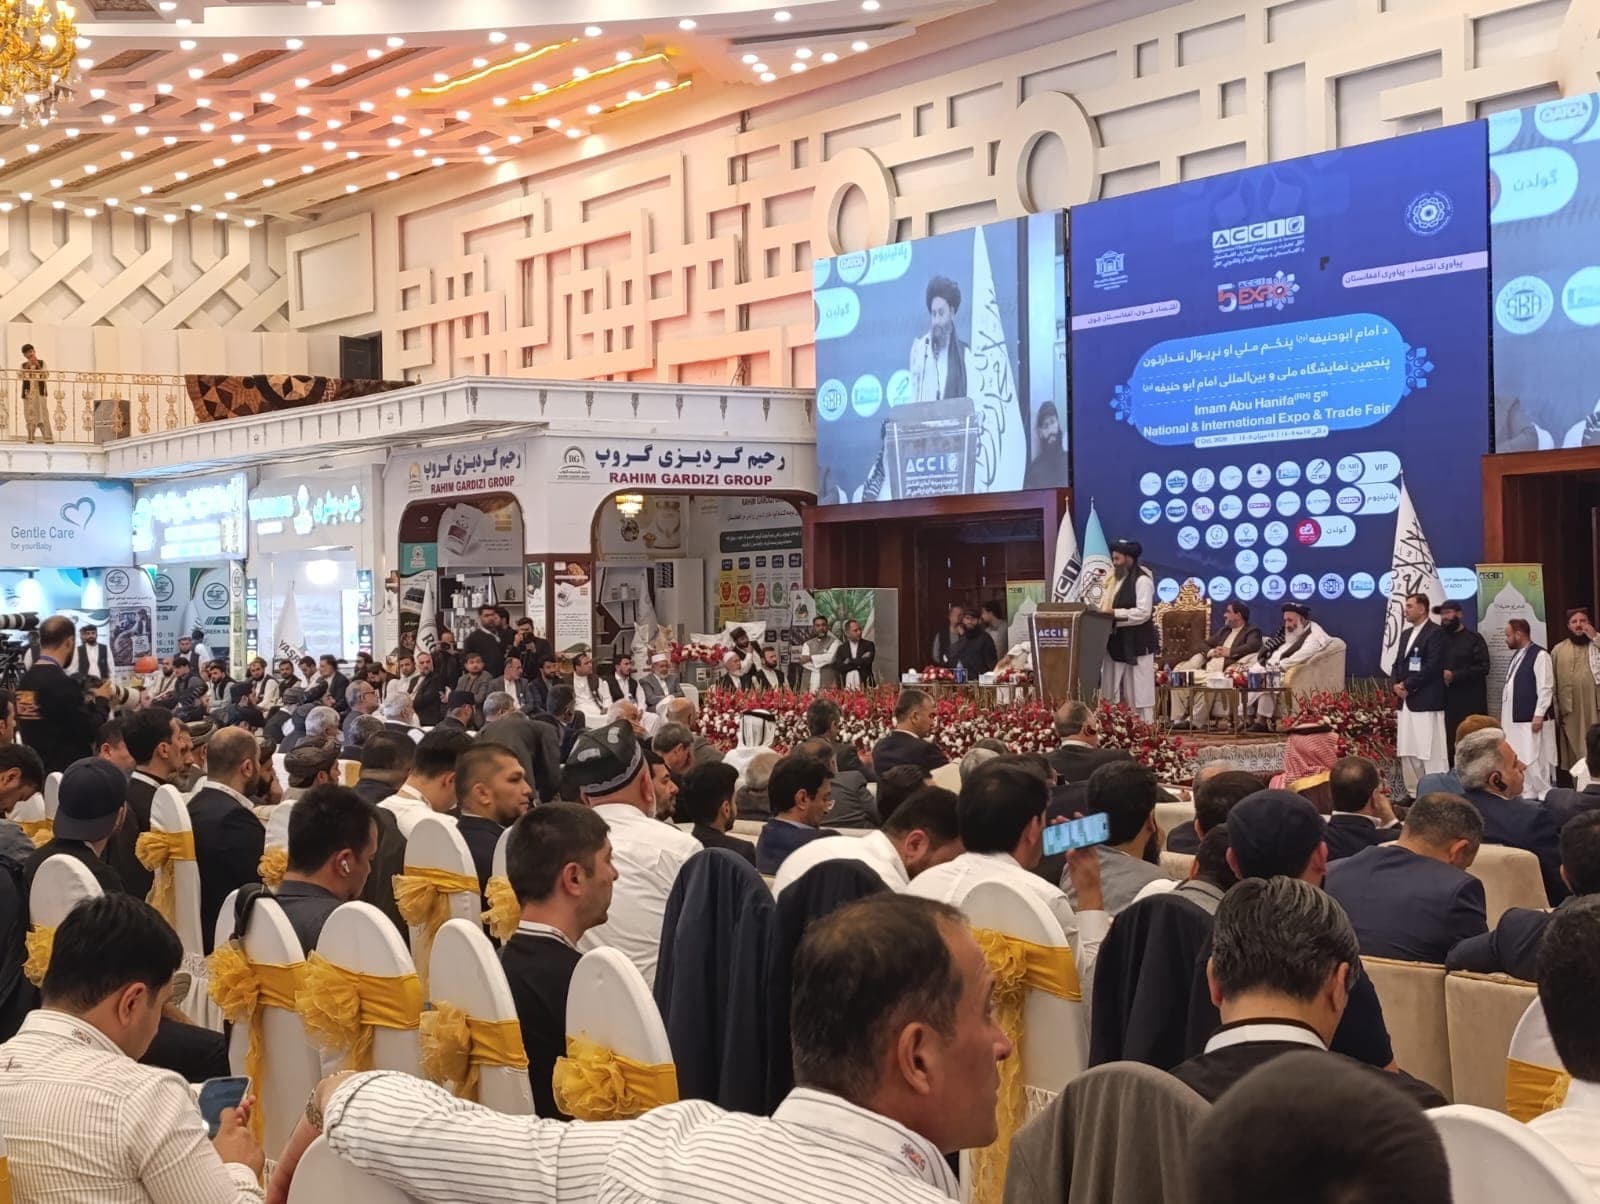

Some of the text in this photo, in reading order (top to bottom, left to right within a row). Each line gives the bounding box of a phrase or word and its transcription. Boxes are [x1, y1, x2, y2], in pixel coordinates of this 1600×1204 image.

[1214, 221, 1281, 246] ACCI
[1355, 324, 1379, 343] امام
[1223, 343, 1233, 357] او
[1300, 360, 1348, 376] نمایشگاه
[1351, 356, 1390, 372] پنجمین
[1269, 372, 1275, 381] و
[1277, 366, 1297, 381] ملی
[1182, 378, 1195, 392] ابو
[1197, 376, 1217, 393] امام
[1194, 403, 1227, 416] Imam
[1229, 400, 1253, 412] Abu
[1143, 403, 1391, 437] National & International Expo & Trade Fair
[423, 447, 521, 480] رحیم گردیزی گروپ
[595, 444, 786, 471] رحیم گردیزی گروپ
[906, 455, 945, 473] ACCI
[1374, 463, 1389, 471] VIP
[431, 475, 515, 494] RAHIM GARDIZI GROUP
[609, 472, 772, 486] RAHIM GARDIZI GROUP
[11, 526, 75, 539] Gentle Care
[10, 542, 21, 550] for
[1039, 628, 1061, 638] ACCI
